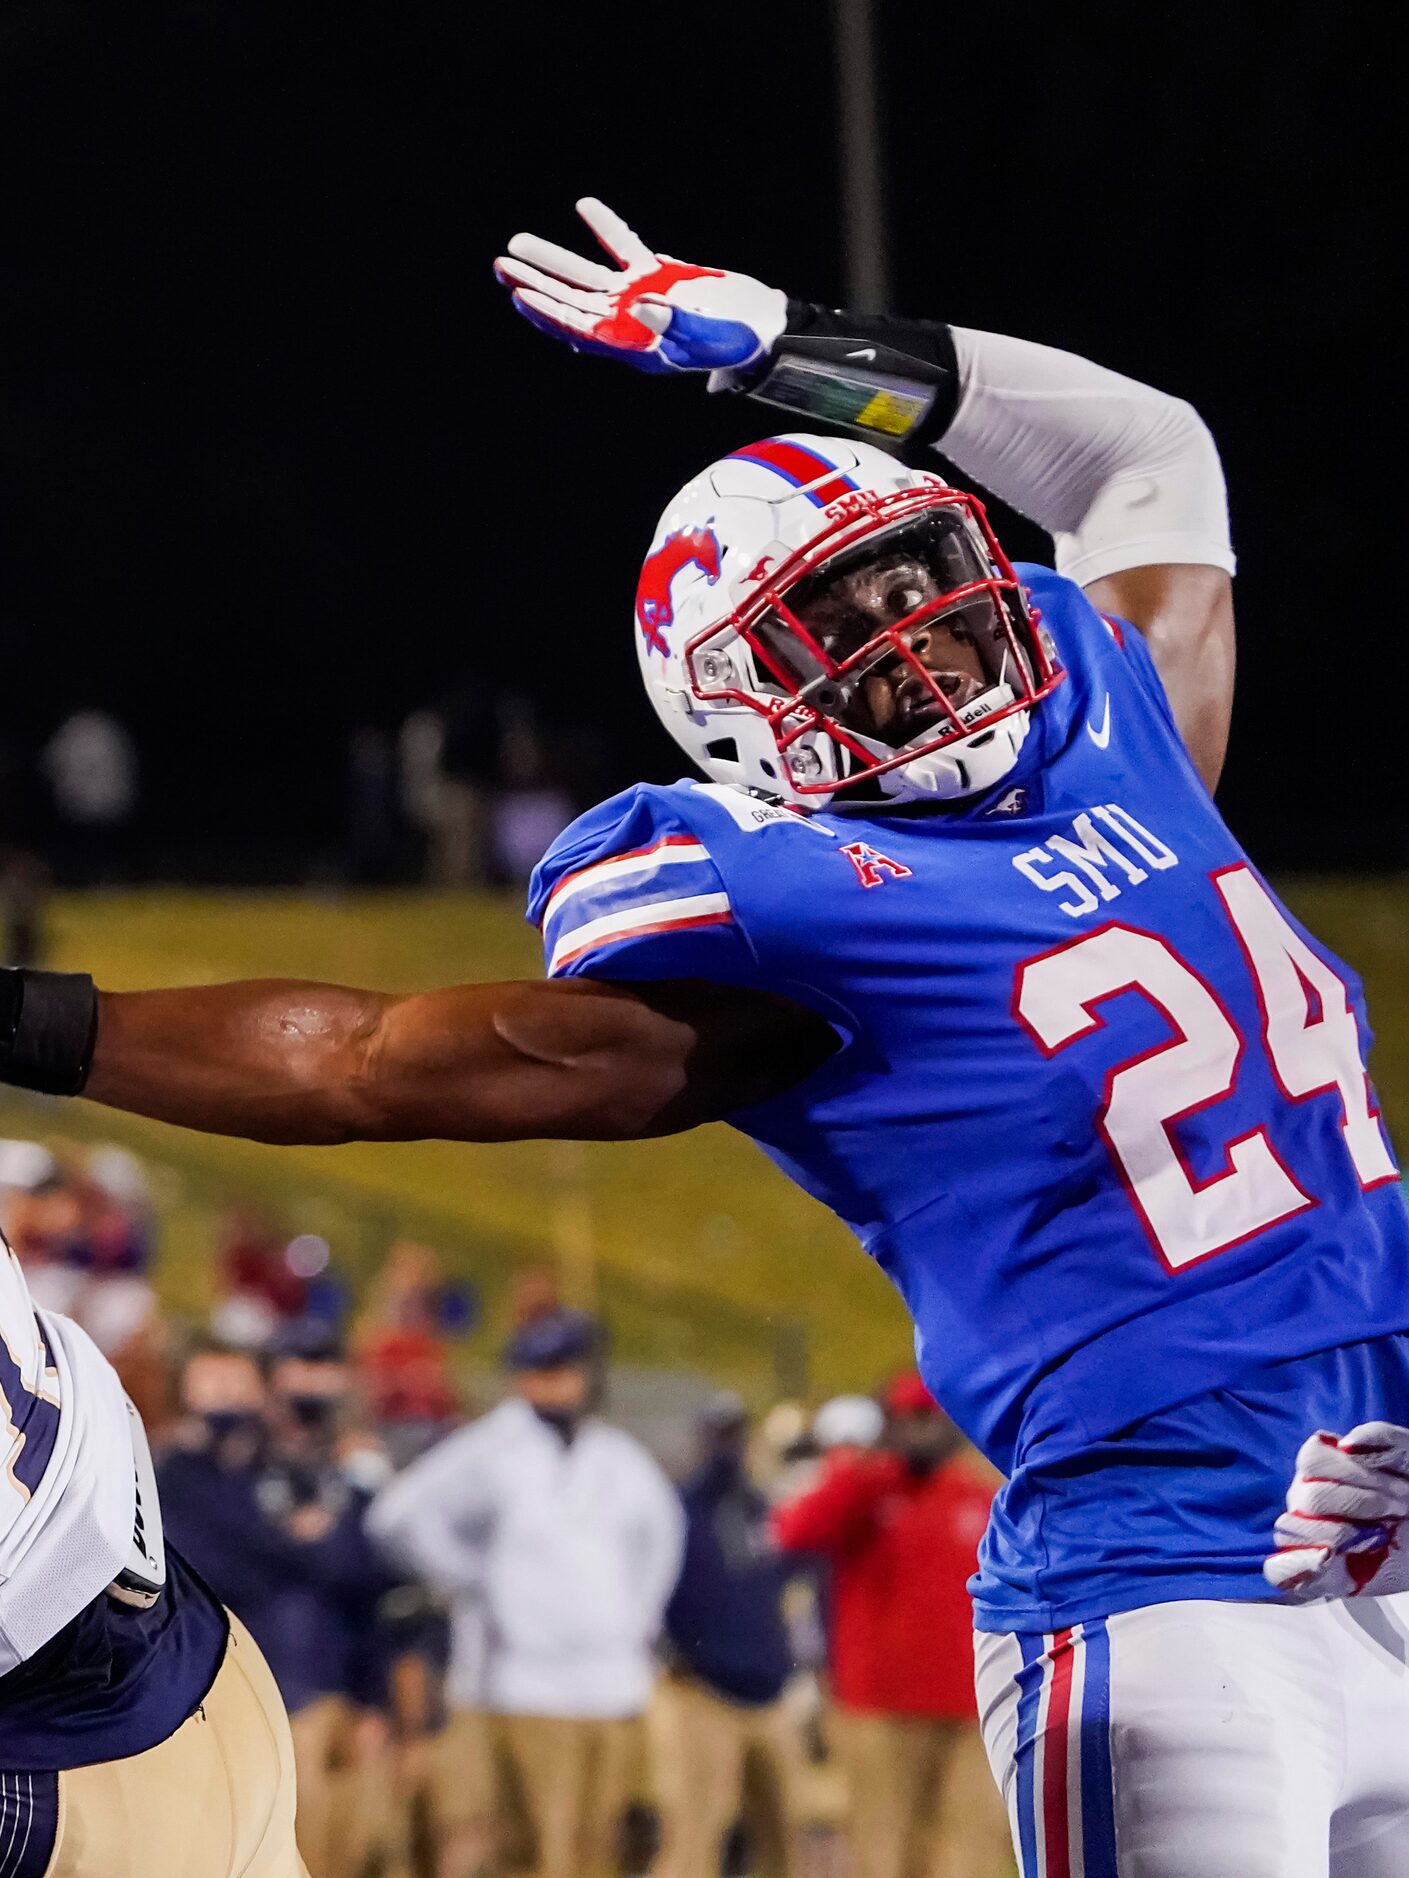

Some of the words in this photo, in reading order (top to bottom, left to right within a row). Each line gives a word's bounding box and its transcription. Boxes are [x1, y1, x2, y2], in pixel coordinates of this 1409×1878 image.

[824, 490, 878, 522] SMU
[937, 703, 993, 737] Rdell
[1012, 803, 1179, 918] SMU
[1010, 861, 1401, 1277] 24
